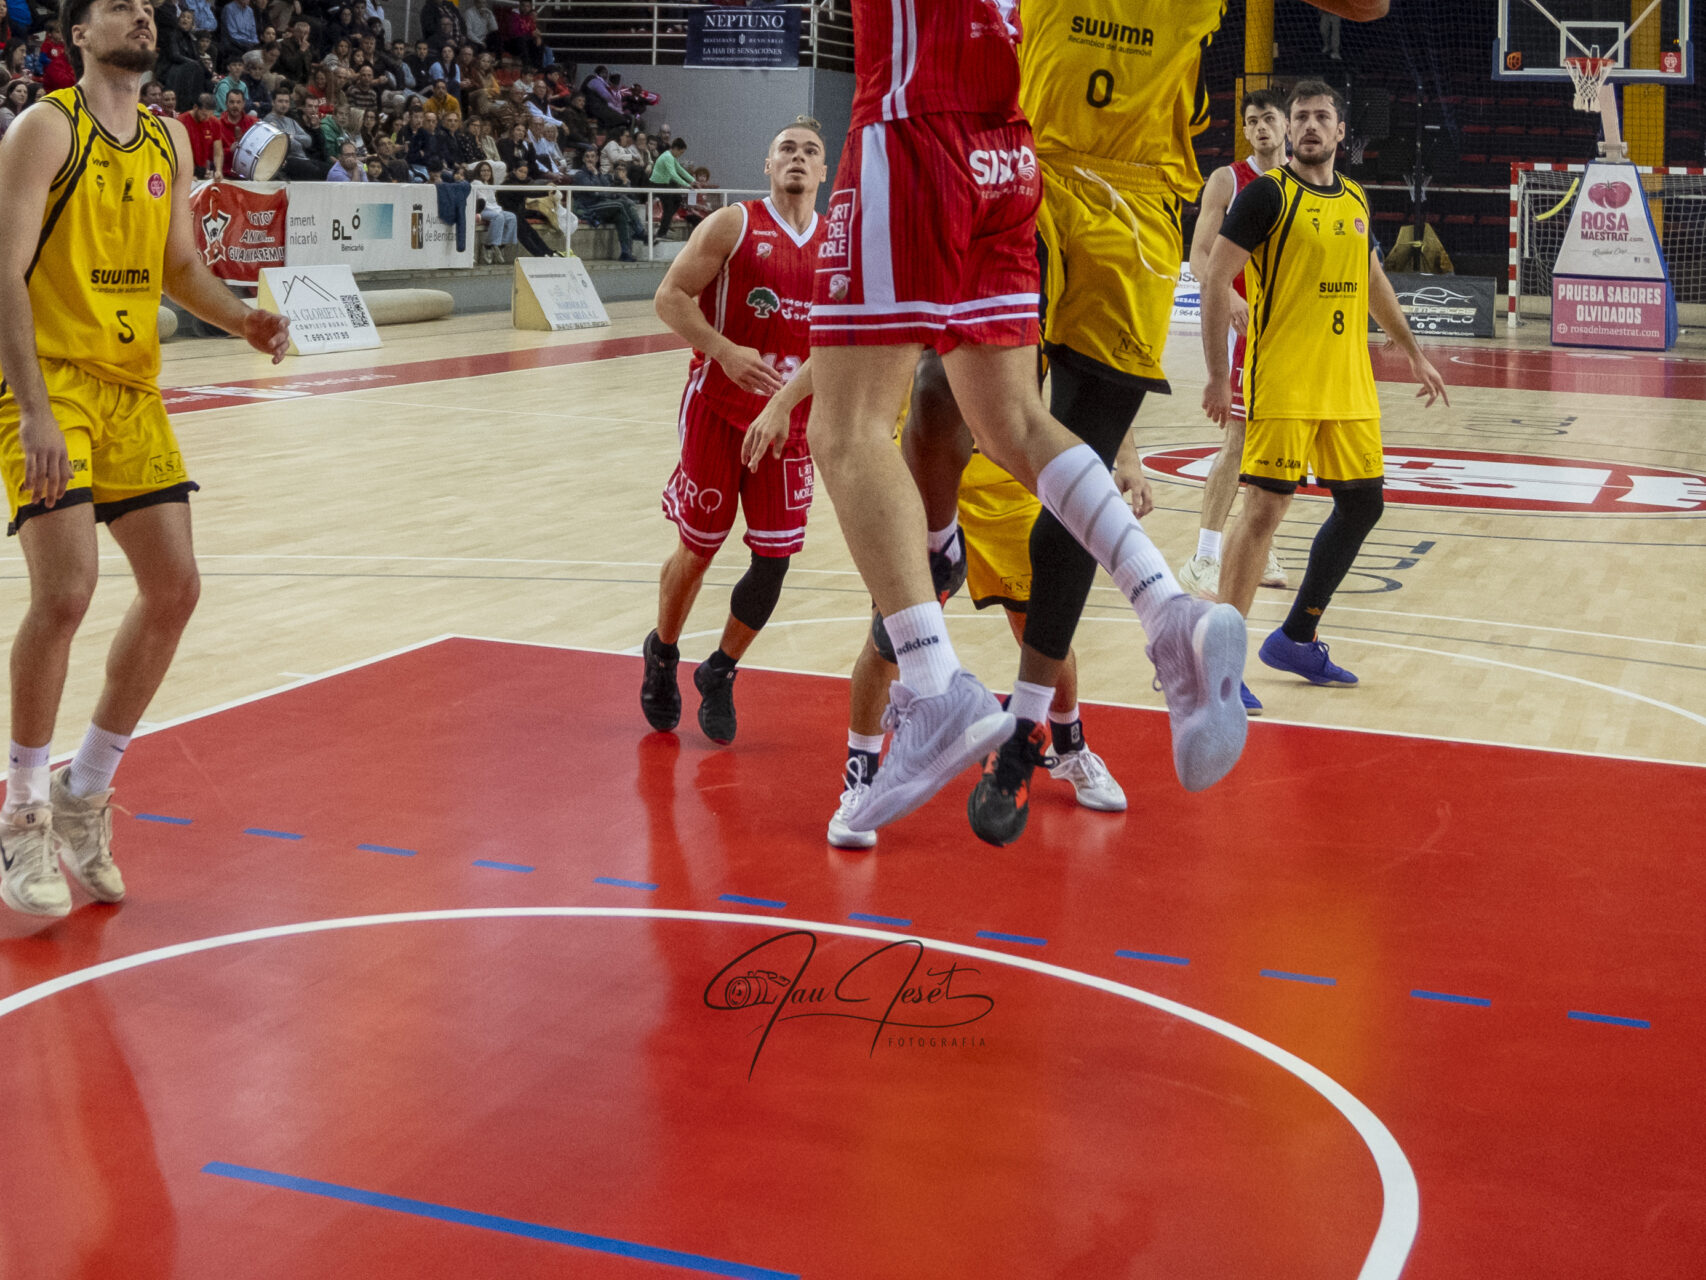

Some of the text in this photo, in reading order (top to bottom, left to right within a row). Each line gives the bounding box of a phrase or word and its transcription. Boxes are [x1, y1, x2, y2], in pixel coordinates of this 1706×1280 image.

[704, 14, 784, 28] NEPTUNO
[1581, 211, 1630, 232] ROSA
[1558, 283, 1662, 305] PRUEBA SABORES
[1332, 310, 1344, 335] 8
[1576, 304, 1642, 325] OLVIDADOS
[116, 310, 134, 344] 5
[1570, 325, 1661, 338] rosadelmaestrat.com
